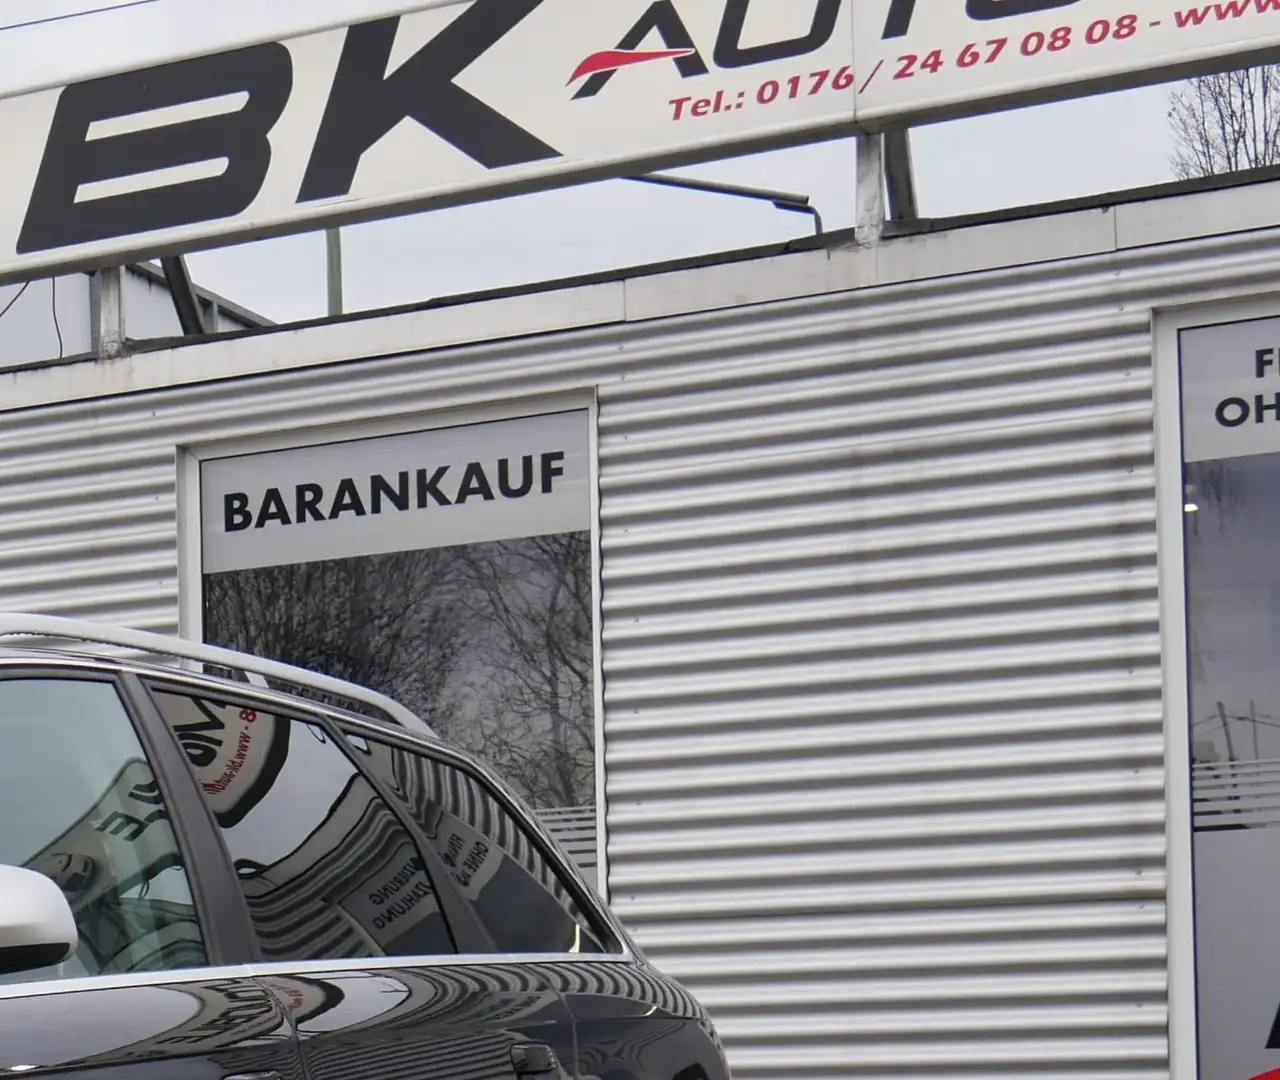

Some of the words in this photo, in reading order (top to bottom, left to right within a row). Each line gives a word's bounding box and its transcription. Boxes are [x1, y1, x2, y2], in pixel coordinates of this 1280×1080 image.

[668, 91, 746, 121] Tel.:
[756, 65, 855, 104] 0176
[893, 49, 944, 80] 24
[956, 37, 1008, 69] 67
[1019, 26, 1072, 57] 08
[1084, 14, 1138, 45] 08
[16, 0, 565, 254] BK
[224, 450, 565, 532] BARANKAUF
